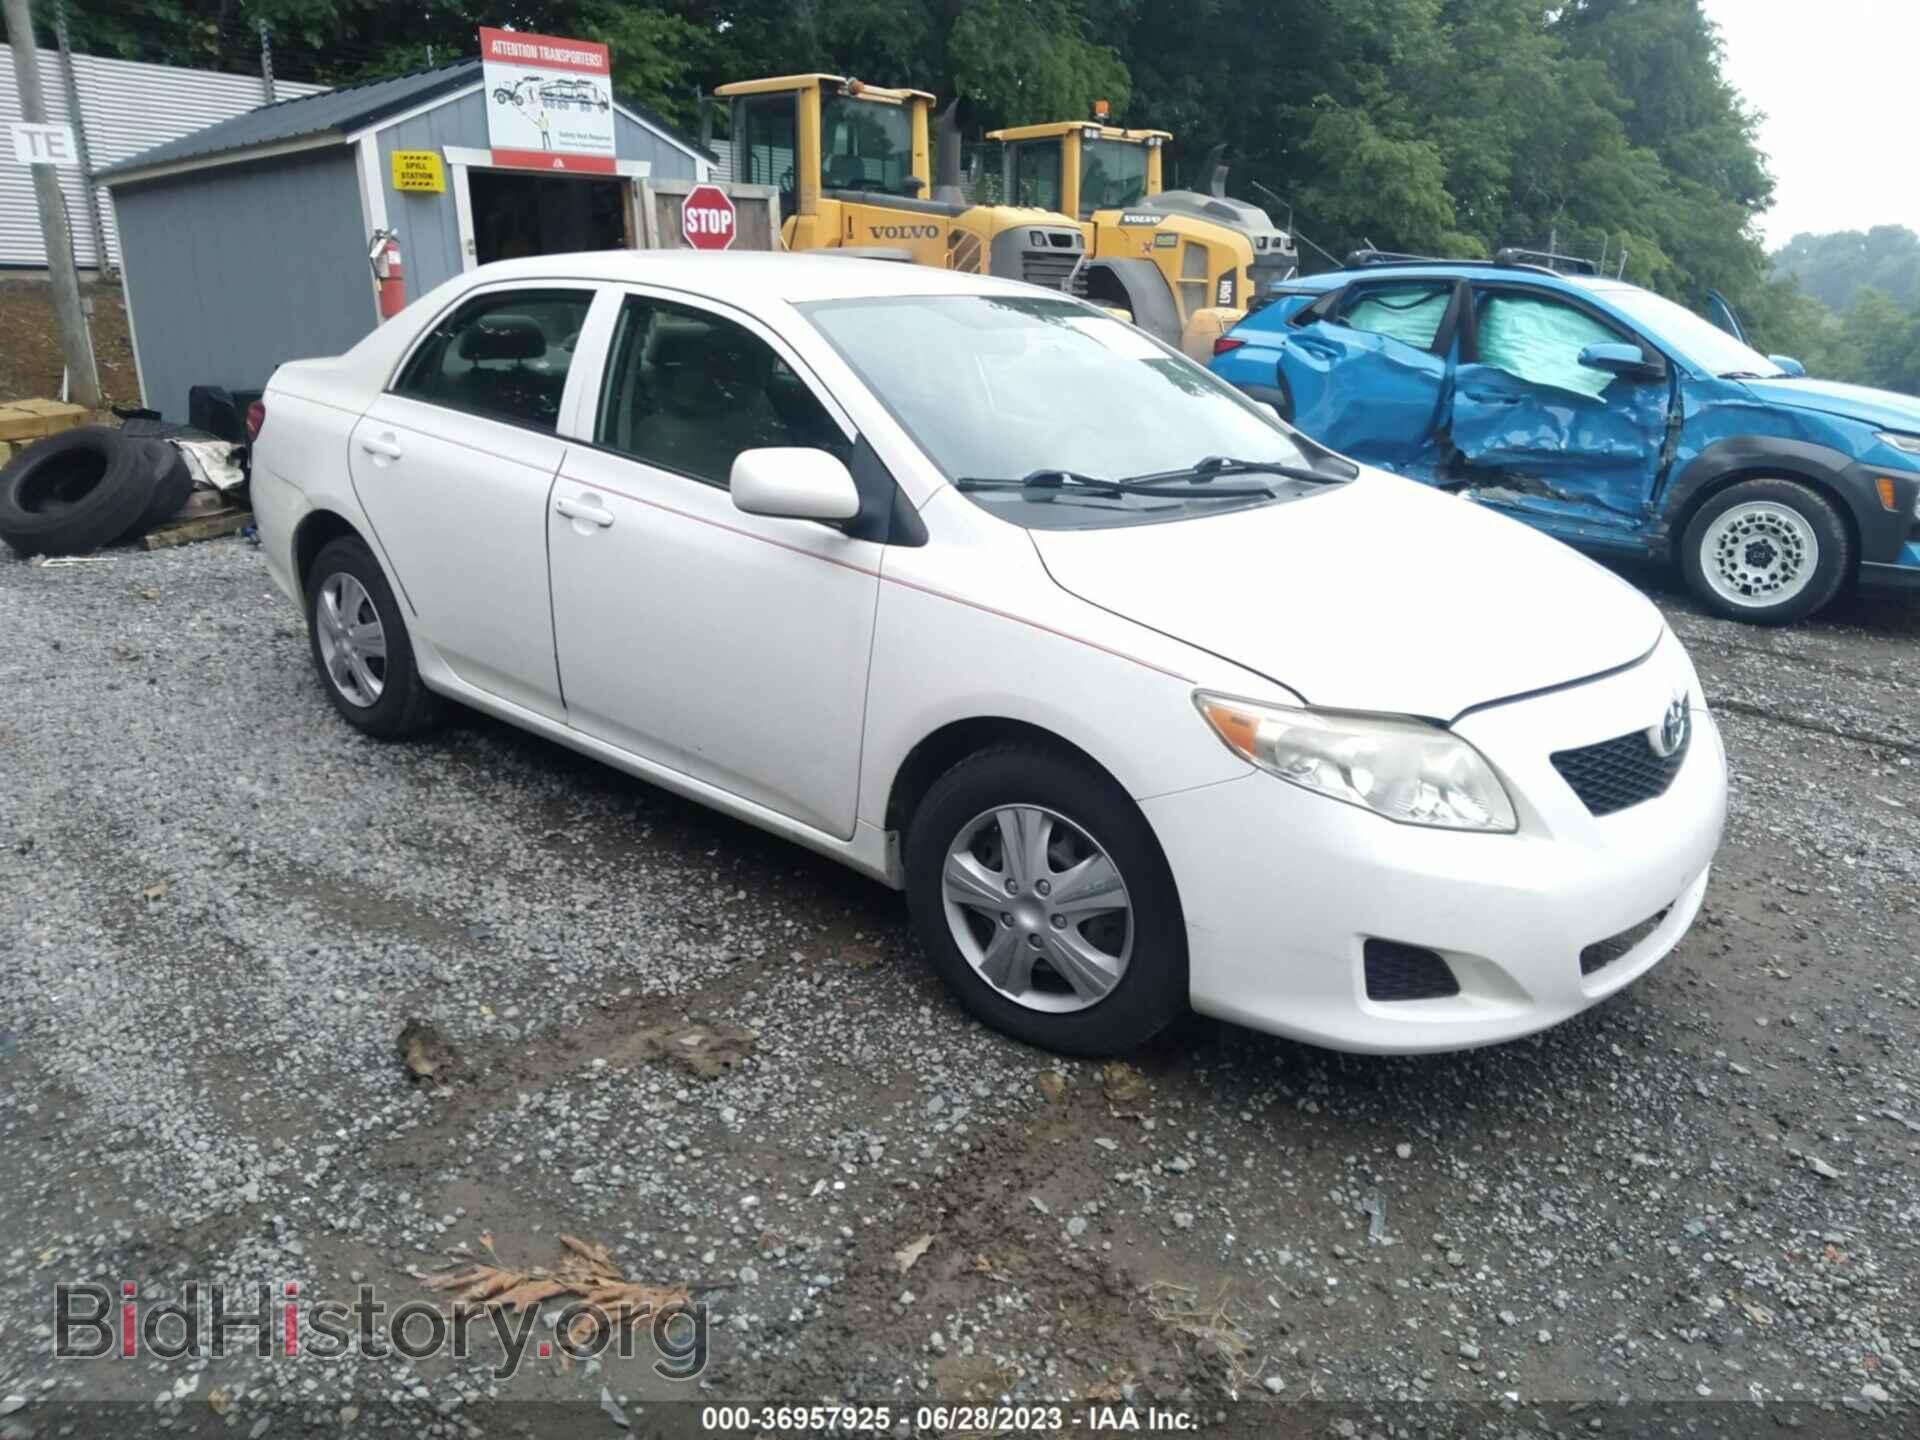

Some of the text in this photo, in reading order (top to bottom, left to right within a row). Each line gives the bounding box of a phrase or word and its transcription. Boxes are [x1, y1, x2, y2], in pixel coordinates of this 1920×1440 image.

[492, 39, 603, 67] ATTENTION TRANSPORTERS!
[19, 129, 67, 158] TE
[405, 162, 427, 170] SPILL
[401, 171, 434, 180] STATION
[686, 207, 732, 235] STOP
[1123, 214, 1161, 224] VOLVO
[869, 224, 940, 240] VOLVO
